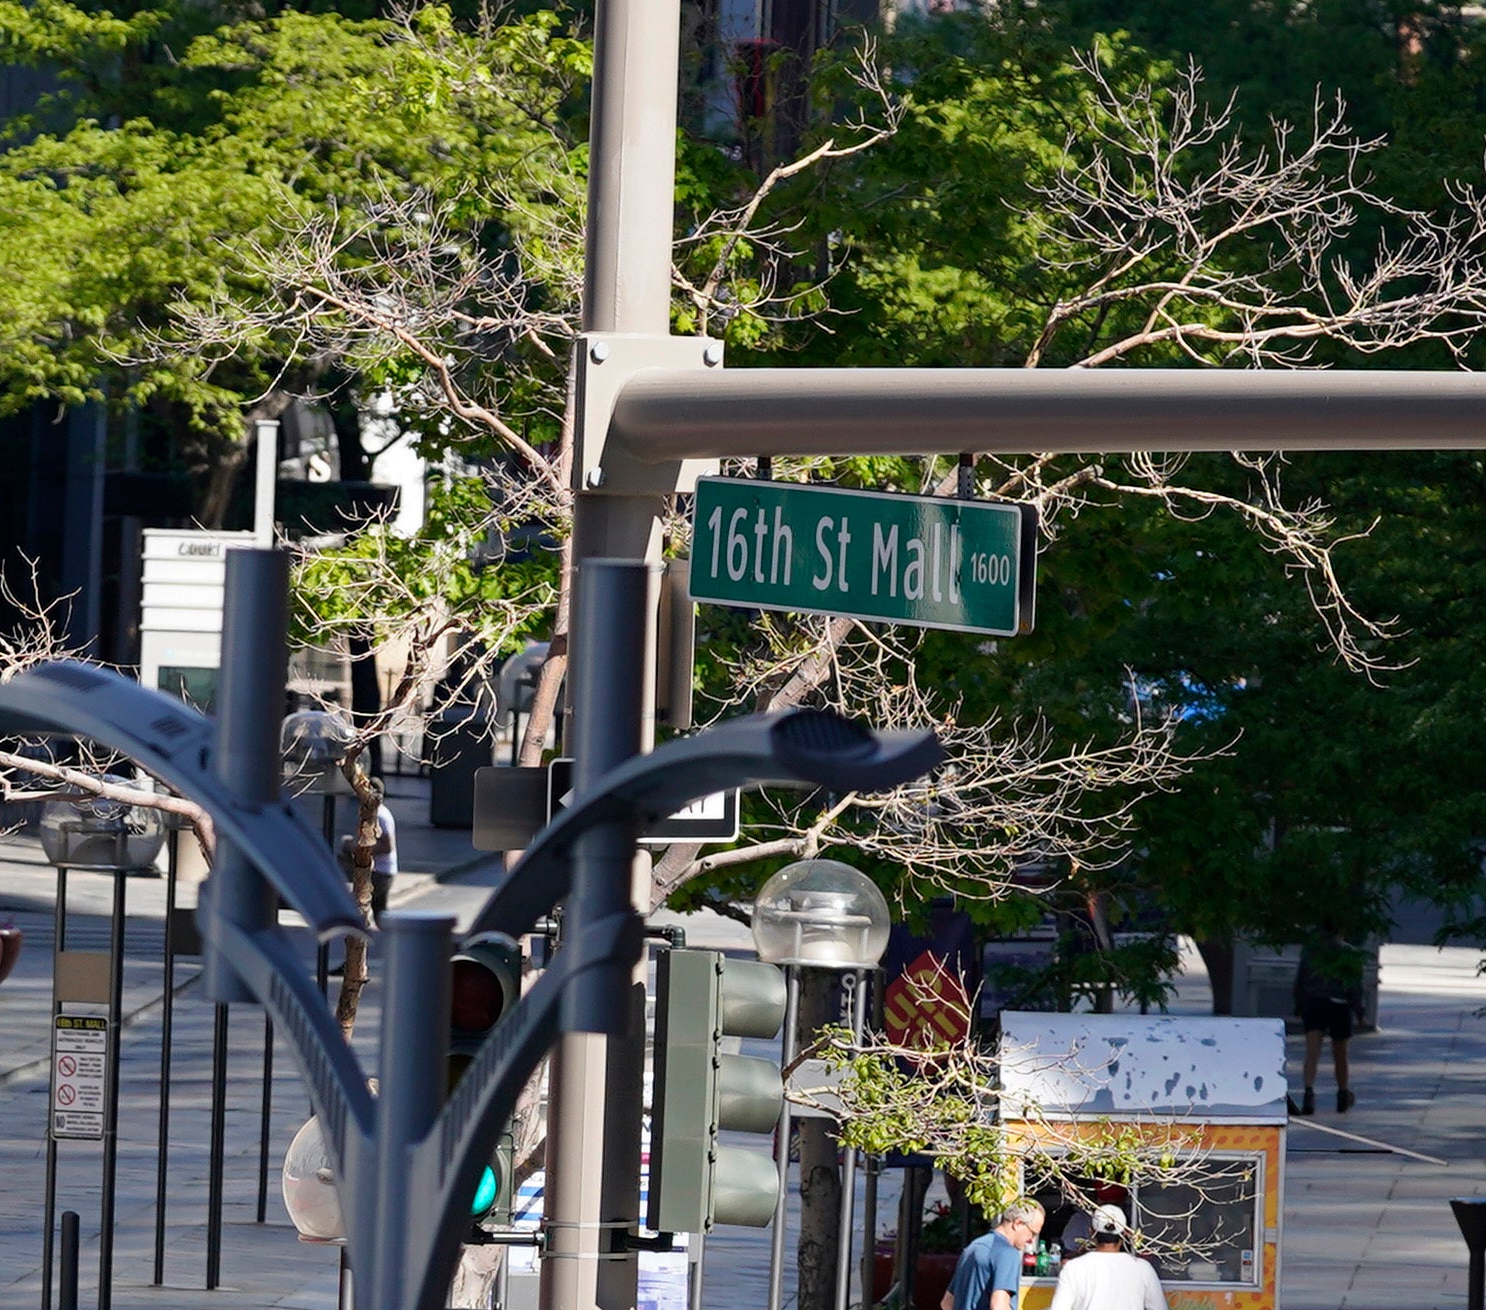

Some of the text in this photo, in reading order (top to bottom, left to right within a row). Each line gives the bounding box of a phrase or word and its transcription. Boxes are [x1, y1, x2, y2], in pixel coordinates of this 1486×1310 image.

[708, 505, 1010, 605] 16th St Mall 1600
